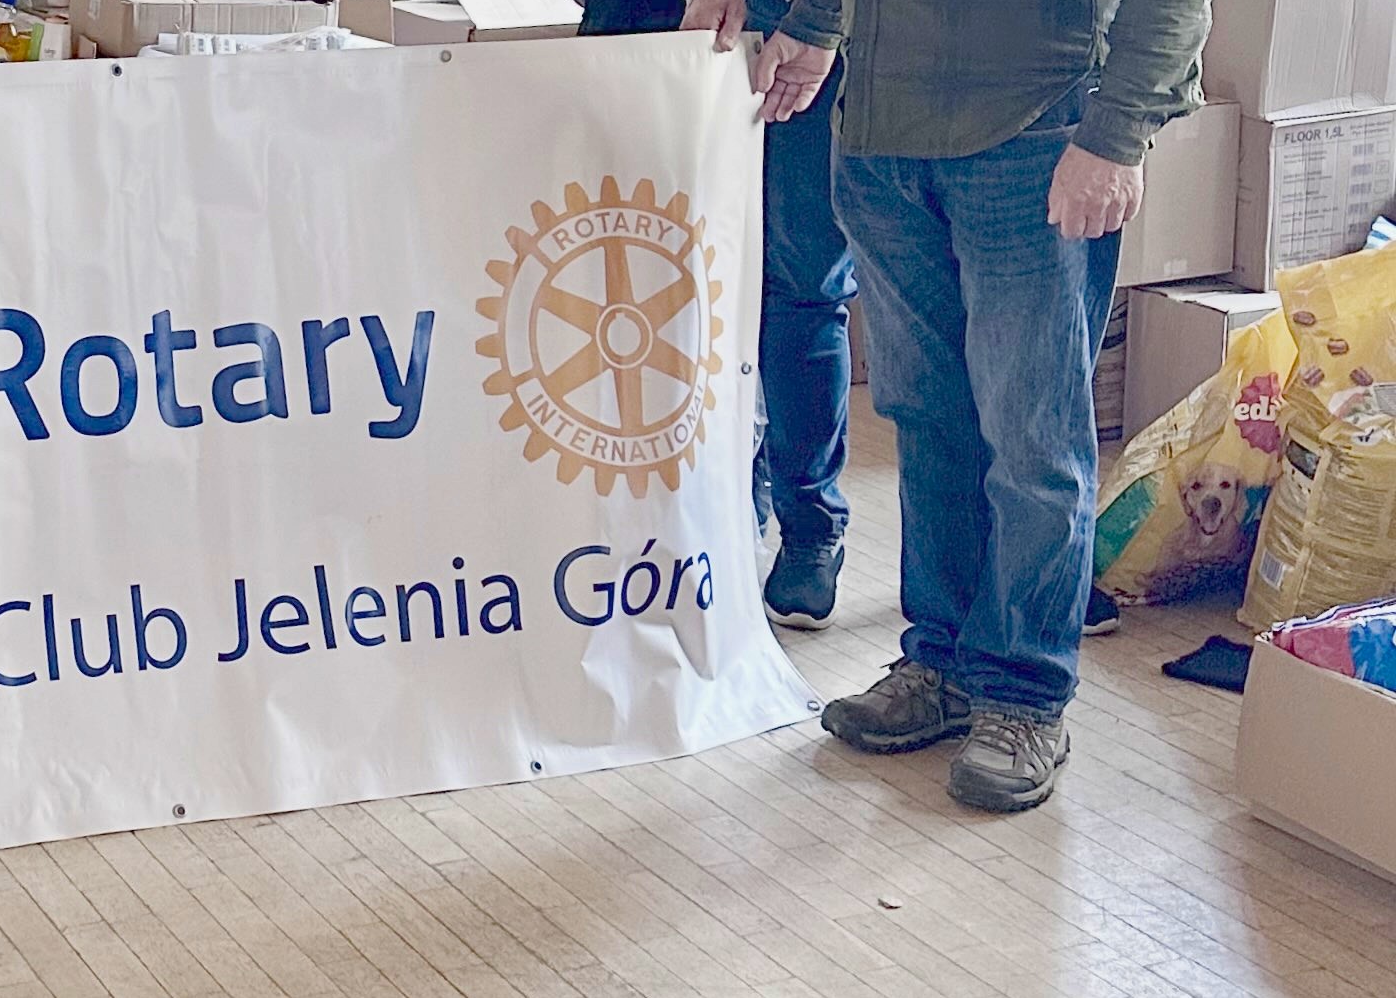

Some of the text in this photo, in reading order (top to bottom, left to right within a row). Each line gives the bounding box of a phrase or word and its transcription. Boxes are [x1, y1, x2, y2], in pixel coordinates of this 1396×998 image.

[1284, 129, 1321, 143] FLOOR
[552, 211, 673, 251] ROTARY
[218, 557, 523, 663] Jelenia
[553, 539, 713, 627] Góra
